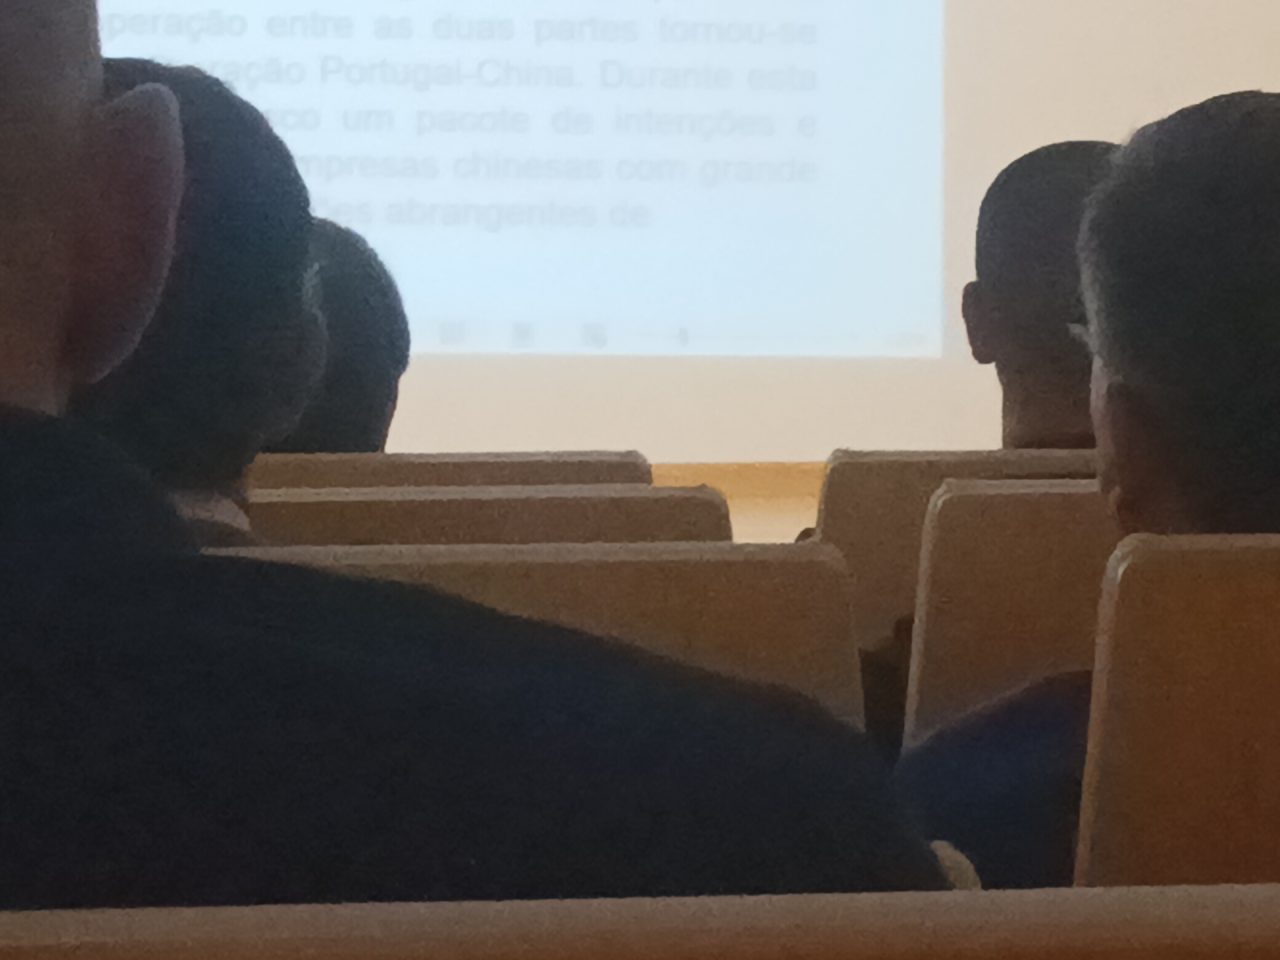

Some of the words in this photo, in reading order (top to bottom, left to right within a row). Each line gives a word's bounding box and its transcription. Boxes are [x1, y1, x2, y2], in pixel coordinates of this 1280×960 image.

[101, 8, 249, 43] peração
[265, 10, 355, 40] entre
[373, 15, 414, 41] as
[432, 14, 515, 41] duas
[534, 18, 640, 47] partes
[658, 17, 819, 45] tornou-se
[599, 58, 734, 90] Durante
[746, 64, 820, 92] esta
[341, 108, 395, 133] um
[416, 107, 531, 136] pacote
[551, 106, 595, 136] de
[615, 104, 776, 143] intenções
[797, 114, 819, 139] e
[452, 152, 602, 180] chinesas
[616, 158, 688, 183] com
[700, 156, 820, 189] grande
[386, 197, 599, 233] abrangentes
[609, 202, 653, 228] de
